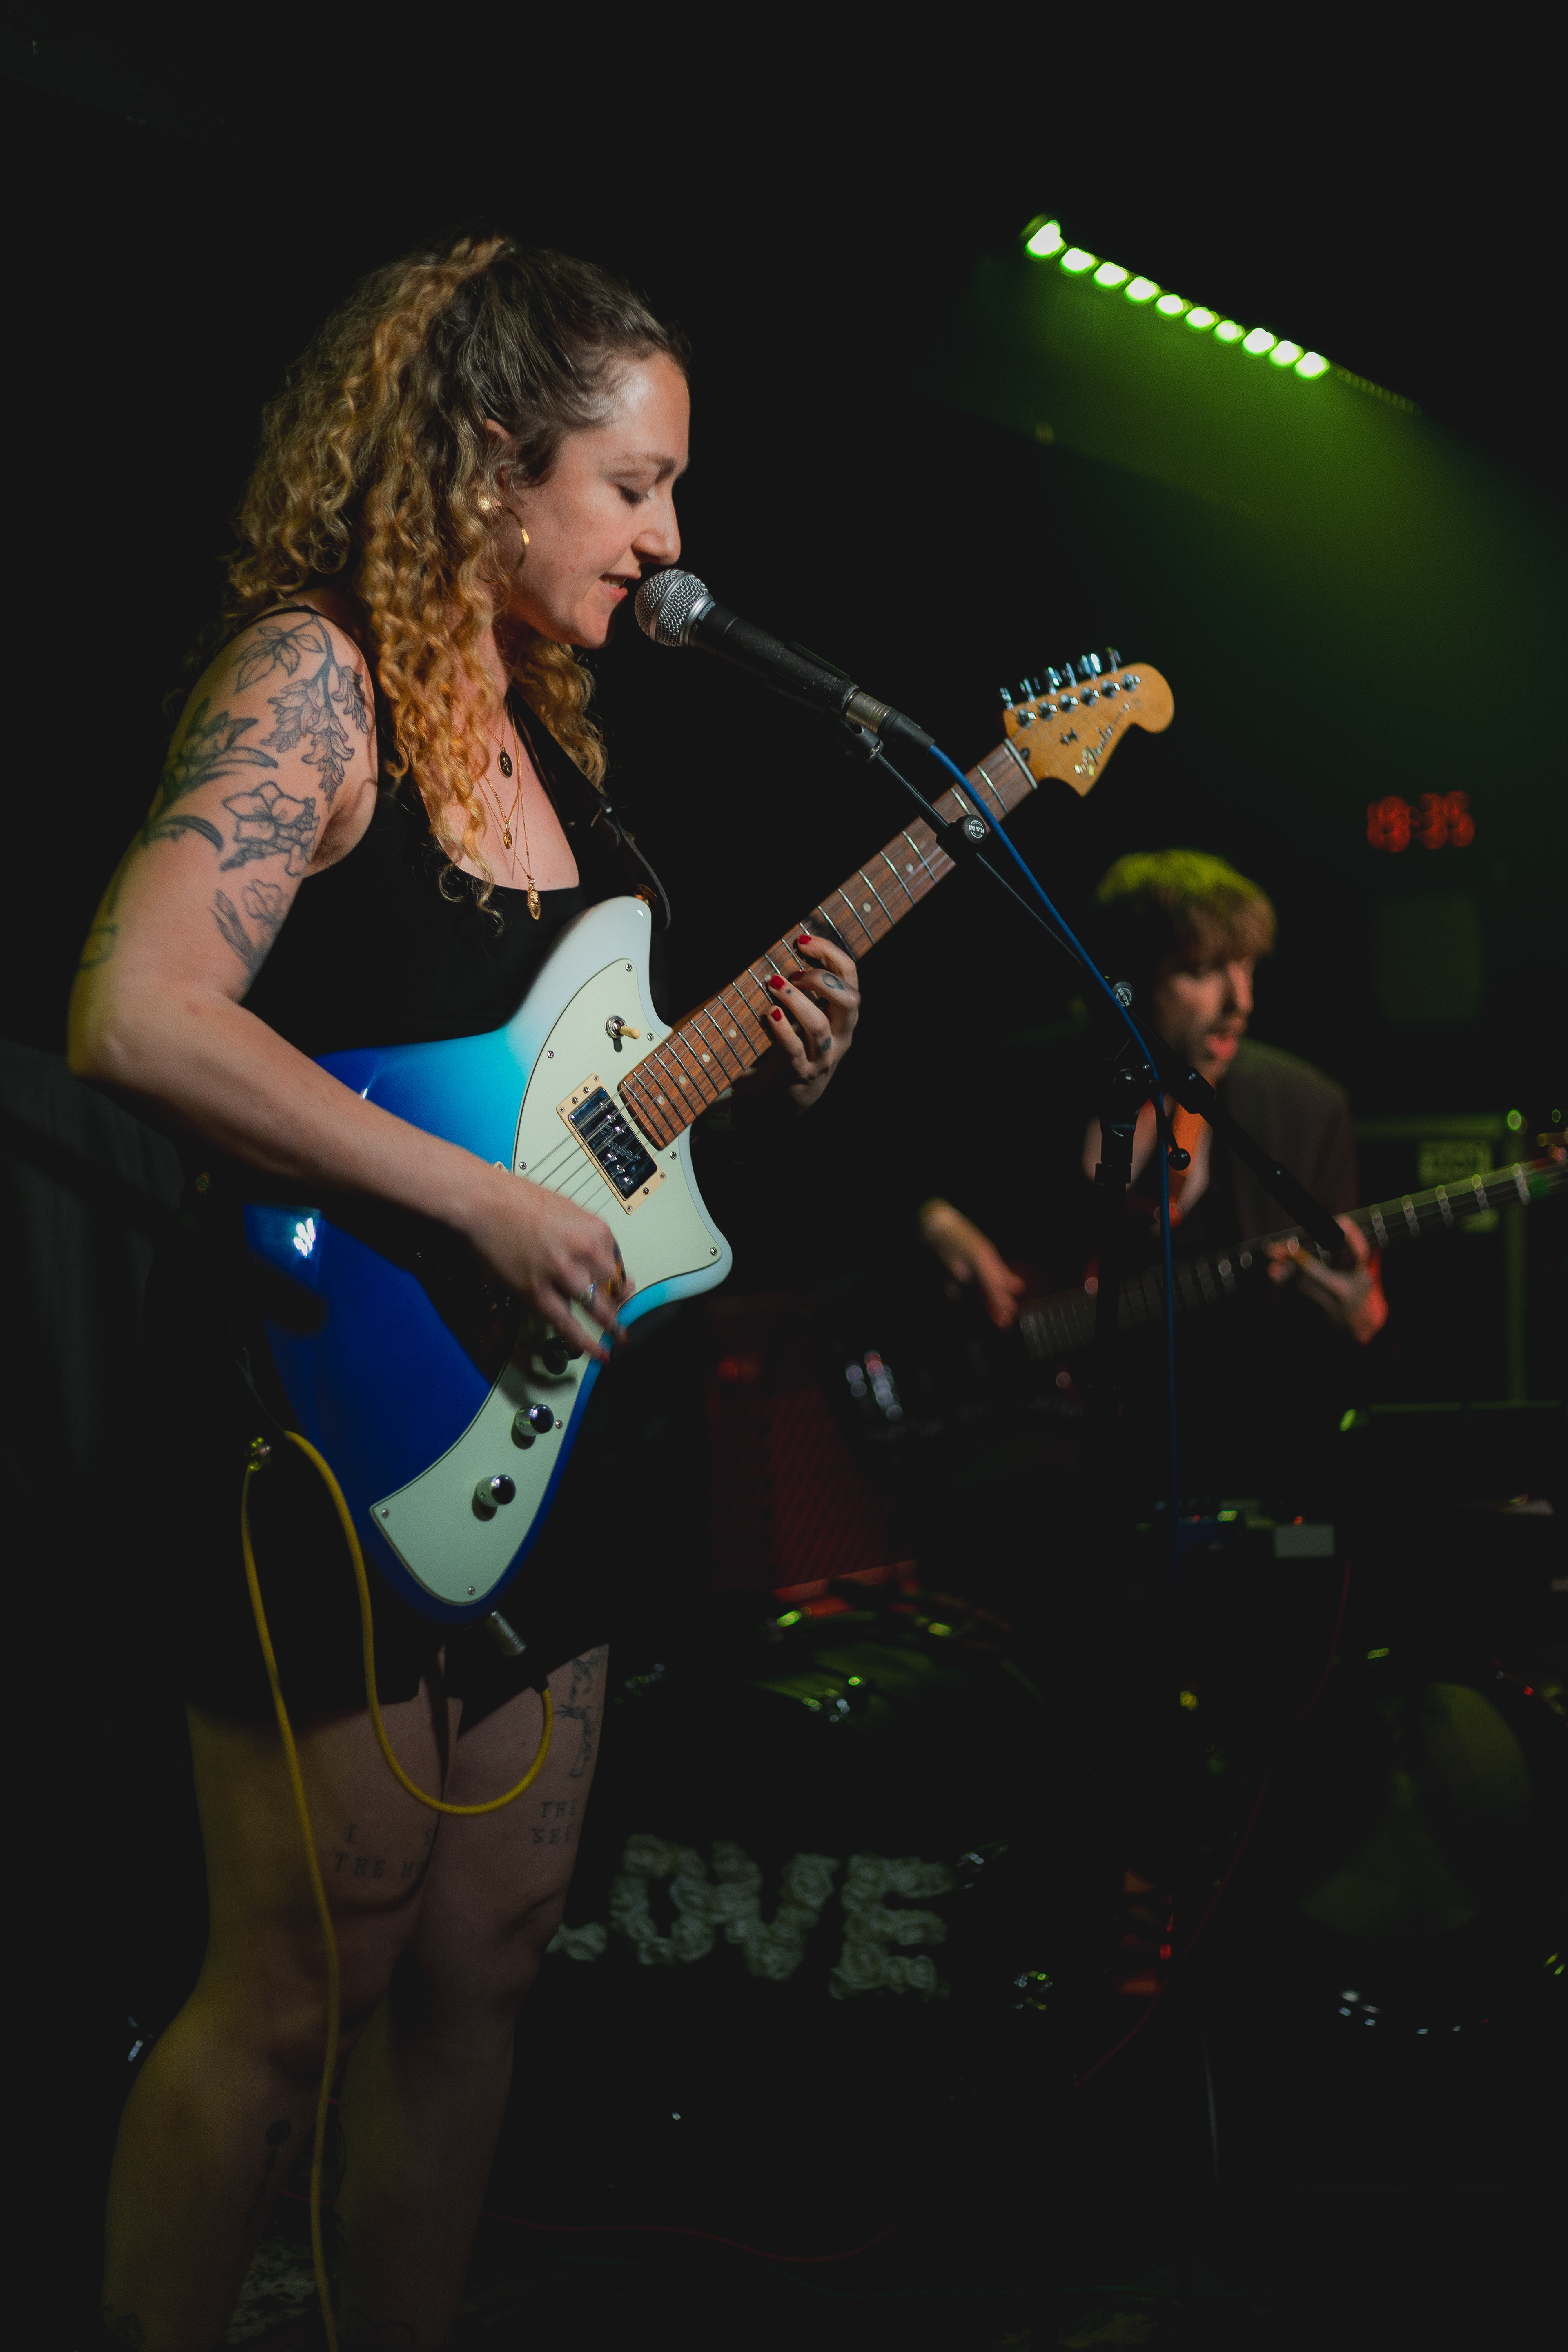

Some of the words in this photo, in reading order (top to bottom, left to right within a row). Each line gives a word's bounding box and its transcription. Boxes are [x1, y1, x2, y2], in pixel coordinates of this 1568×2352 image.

[698, 601, 716, 621] SHURE
[969, 823, 984, 834] K&M
[1117, 987, 1130, 1007] K&M
[334, 1852, 386, 1878] THE
